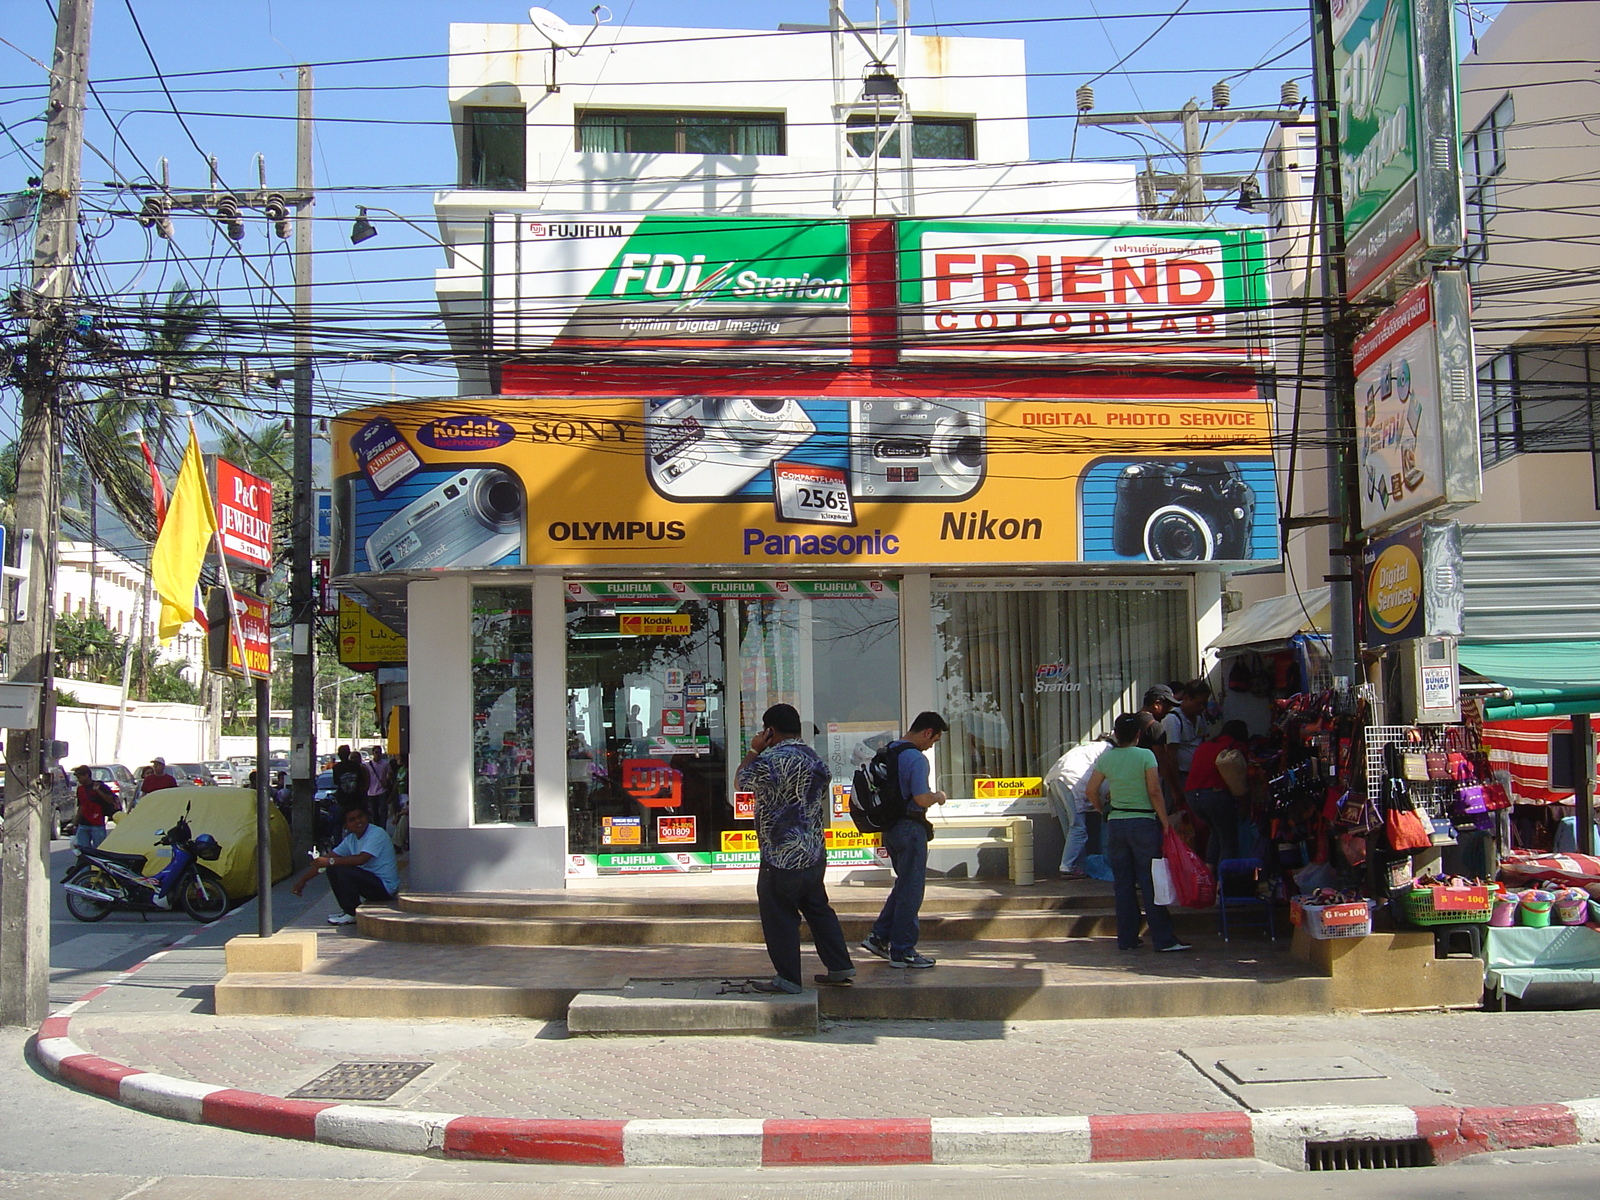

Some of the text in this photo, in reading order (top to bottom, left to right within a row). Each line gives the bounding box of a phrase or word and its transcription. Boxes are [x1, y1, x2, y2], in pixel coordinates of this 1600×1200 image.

[548, 224, 622, 238] FUJIFILM
[732, 270, 843, 300] Station
[934, 254, 1216, 305] FRIEND
[676, 318, 720, 333] Digital
[725, 319, 780, 334] Imaging
[1022, 412, 1256, 426] DIGITAL PHOTO SERVICE
[434, 421, 500, 438] Kodak
[532, 422, 631, 443] SONY
[435, 438, 500, 448] Technology
[366, 442, 385, 461] 256
[370, 444, 406, 473] Kingston
[234, 476, 258, 511] P&C
[798, 488, 848, 511] 256 MB
[220, 504, 270, 544] JEWELRY
[548, 521, 686, 542] OLYMPUS
[939, 510, 1042, 541] Nikon
[743, 529, 900, 556] Panasonic
[1380, 558, 1409, 590] Digital
[608, 584, 652, 592] FUJIFILM
[712, 583, 754, 592] FUJIFILM
[814, 583, 856, 591] FUJIFILM
[1378, 587, 1413, 612] Services
[644, 617, 672, 625] Kodak
[1035, 681, 1081, 693] Station
[832, 735, 842, 784] EasyShare
[997, 780, 1025, 788] Kodak
[662, 828, 690, 836] 001809
[611, 856, 656, 864] FUJIFILM
[716, 853, 760, 862] FUJIFILM
[826, 850, 863, 860] UJIFILM
[1467, 896, 1484, 904] 100
[1349, 908, 1366, 916] 100
